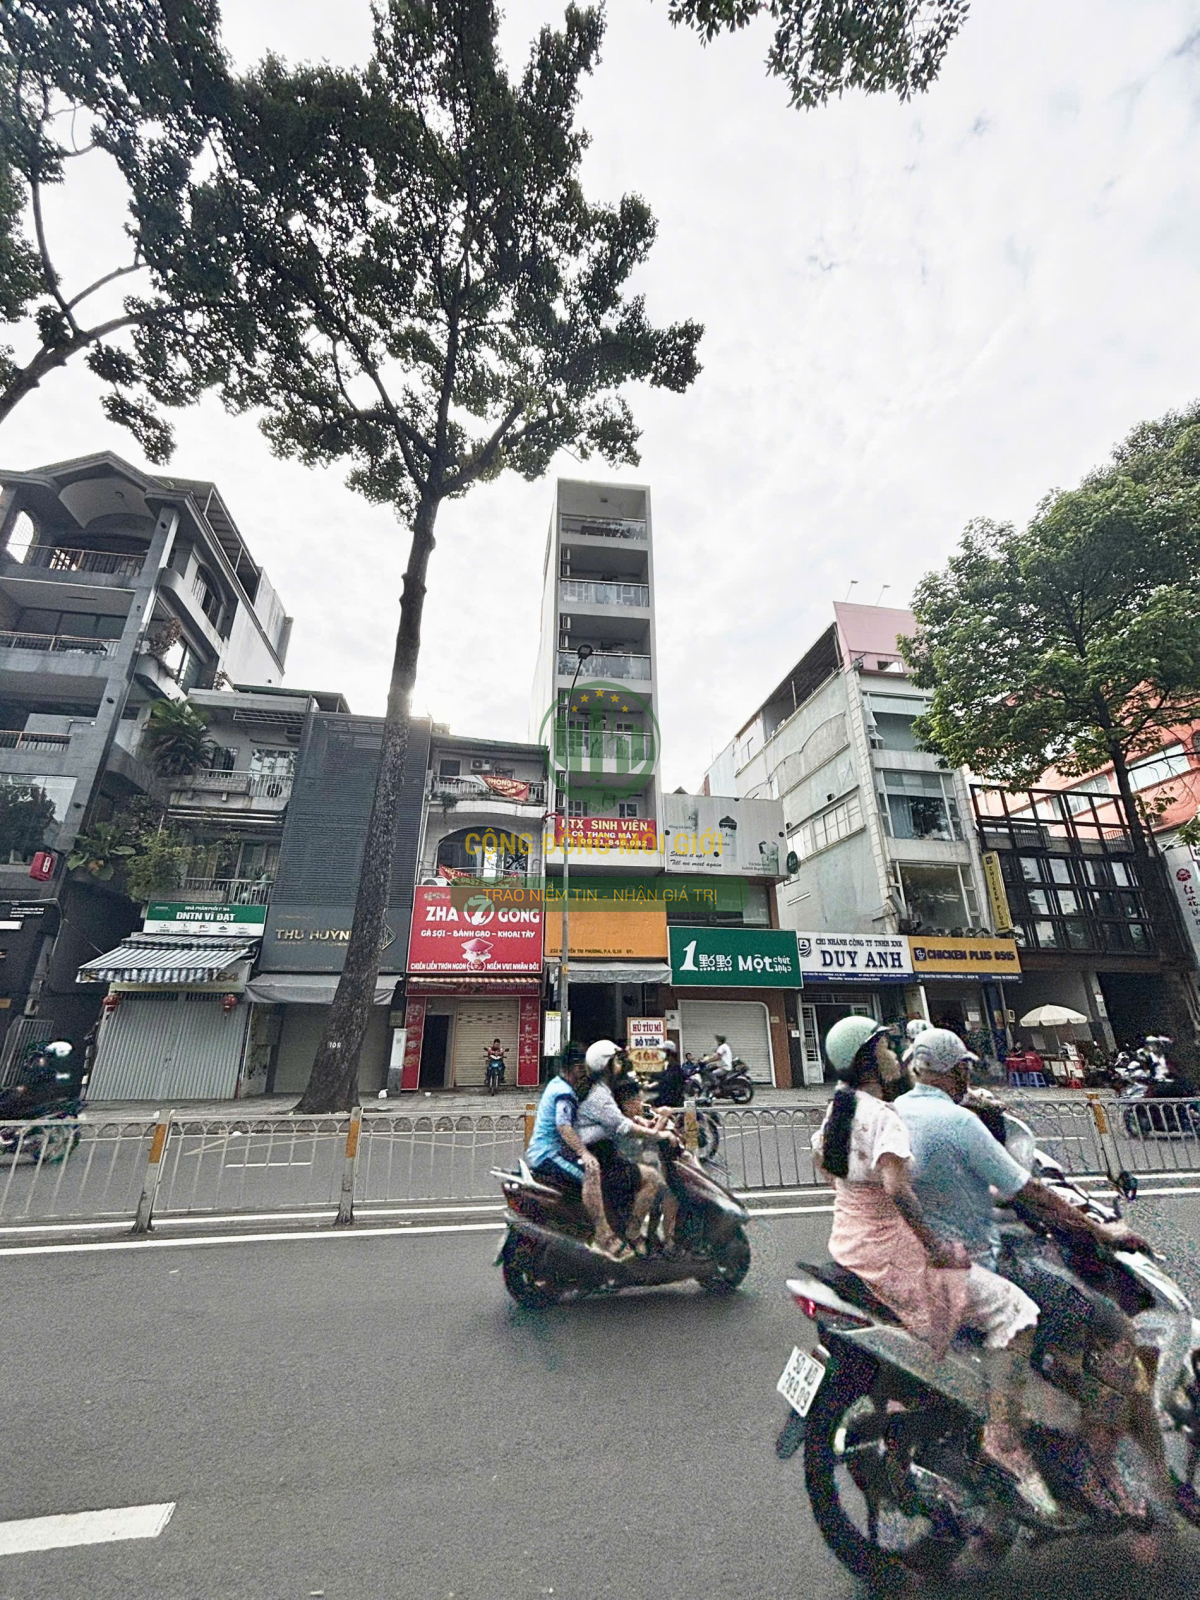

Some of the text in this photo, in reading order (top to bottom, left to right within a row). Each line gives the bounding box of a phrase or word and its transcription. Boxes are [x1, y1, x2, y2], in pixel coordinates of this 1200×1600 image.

[591, 820, 618, 831] SINH
[621, 819, 648, 831] VIÊN
[586, 831, 616, 839] THANG
[618, 831, 638, 839] MÁY
[176, 911, 204, 920] DNTN
[425, 906, 459, 922] ZHA
[498, 907, 540, 923] GONG
[275, 928, 352, 940] THU HUỲN
[421, 928, 432, 937] GÀ
[432, 929, 446, 938] SỢI
[453, 928, 473, 937] BÁNH
[475, 930, 490, 938] GẠO
[498, 930, 520, 938] KHOAI
[815, 938, 826, 946] CHI
[827, 938, 848, 947] NHÁNH
[848, 938, 864, 947] CÔNG
[821, 950, 904, 968] DUY ANH
[927, 949, 968, 960] CHICKEN
[969, 950, 992, 961] PLUS
[737, 954, 774, 973] Một
